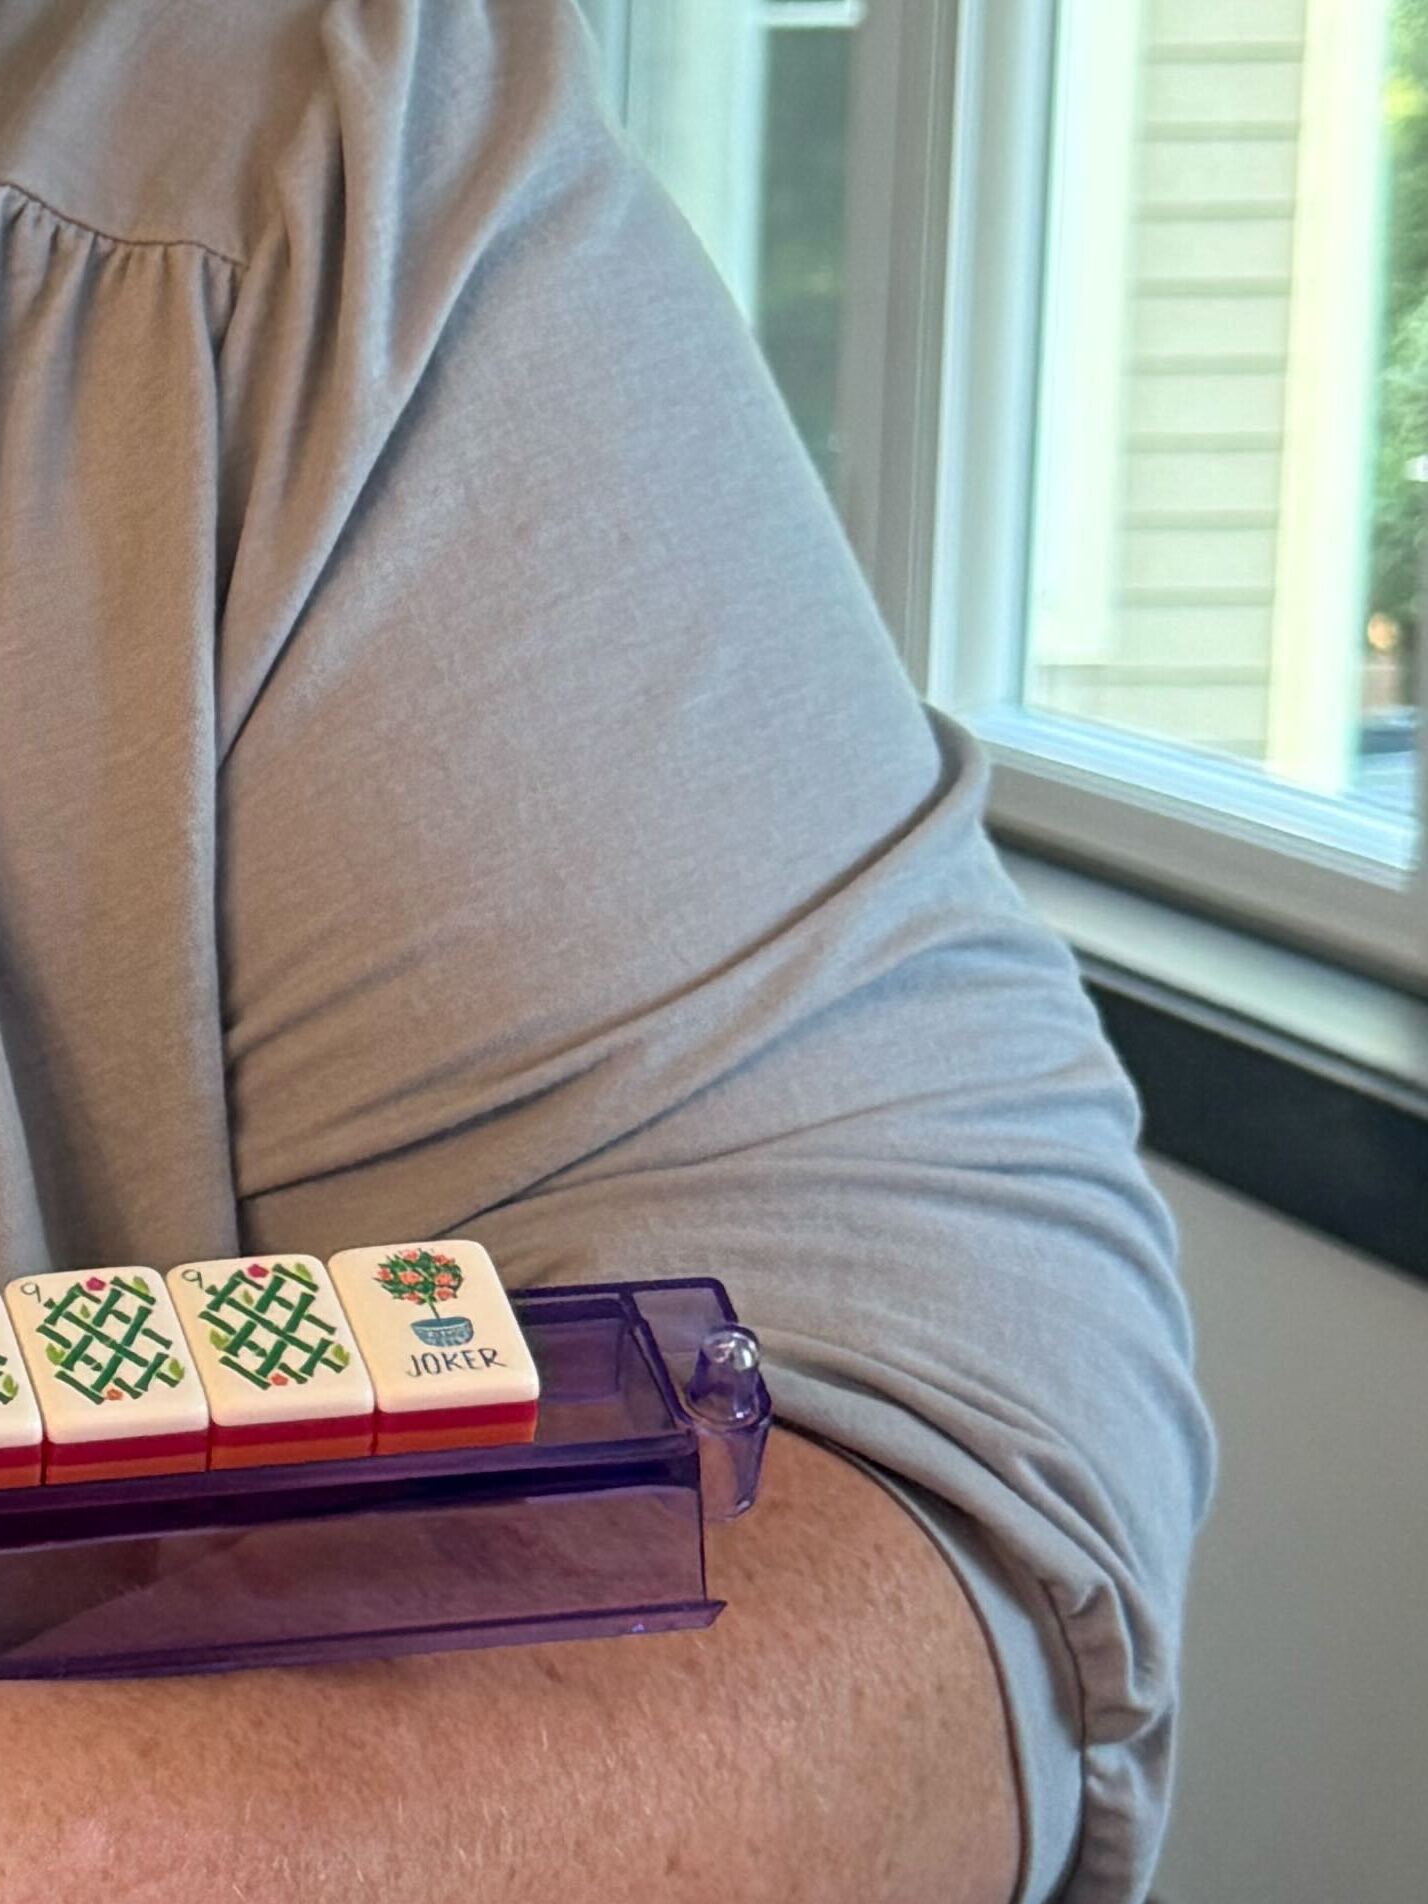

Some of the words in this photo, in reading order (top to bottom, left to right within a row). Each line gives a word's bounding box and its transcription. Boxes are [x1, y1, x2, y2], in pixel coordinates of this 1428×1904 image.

[183, 1266, 203, 1290] 9
[23, 1281, 45, 1305] 9
[408, 1345, 508, 1381] JOKER
